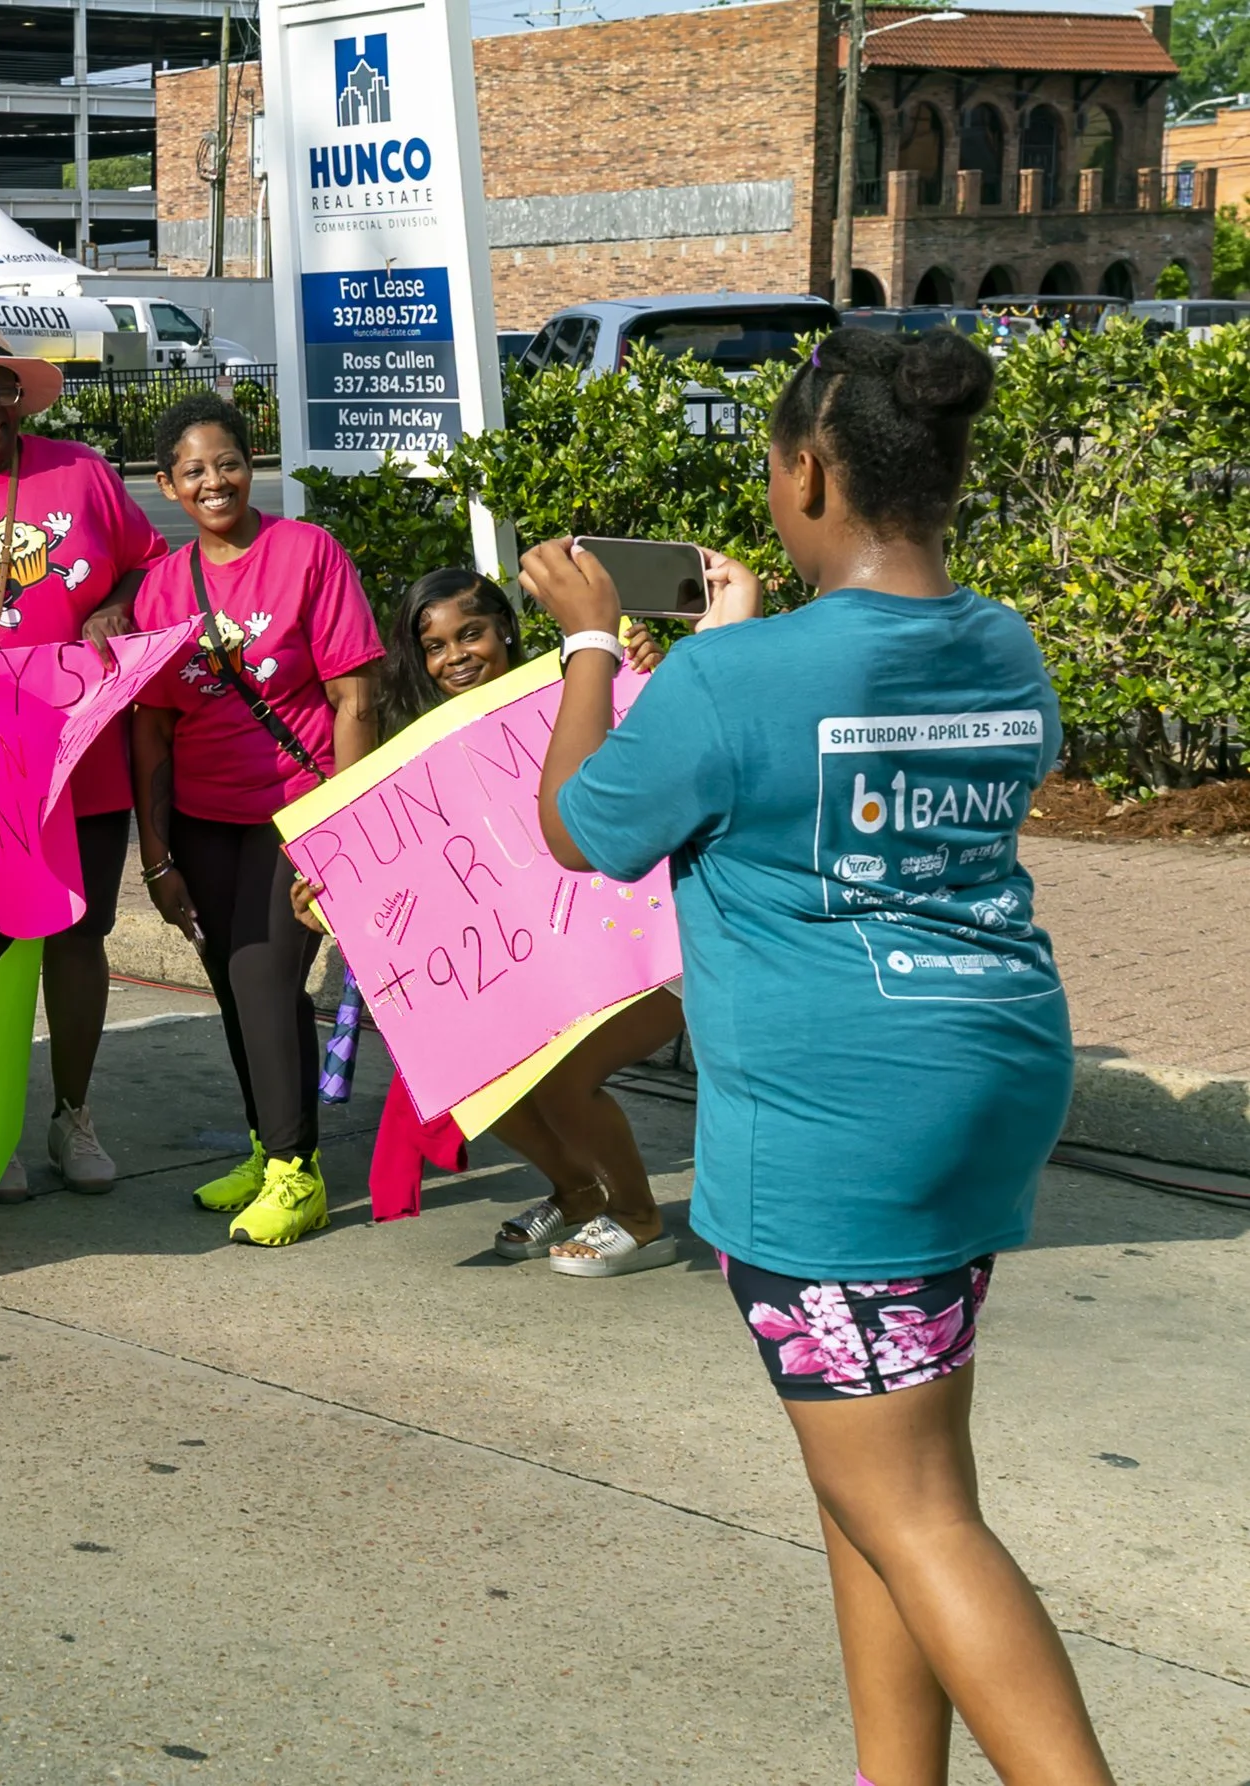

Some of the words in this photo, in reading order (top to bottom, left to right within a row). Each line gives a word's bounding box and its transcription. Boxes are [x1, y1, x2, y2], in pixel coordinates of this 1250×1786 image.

[309, 138, 431, 188] HUNCO
[312, 193, 354, 210] REAL
[365, 188, 433, 206] ESTATE
[314, 220, 383, 233] COMMERCIAL
[388, 216, 438, 229] DIVISION
[339, 277, 368, 299] For
[374, 276, 425, 298] Lease
[333, 304, 438, 326] 337.889.5722
[343, 352, 381, 370] Ross
[385, 351, 435, 369] Cullen
[333, 375, 446, 393] 337.384.5150
[338, 408, 383, 426] Kevin
[389, 408, 443, 430] McKay
[334, 433, 448, 450] 337.277.0478
[831, 727, 917, 745] SATURDAY
[928, 724, 969, 741] APRIL
[972, 723, 990, 738] 25
[1002, 720, 1037, 737] 2026
[302, 762, 450, 901] RUN
